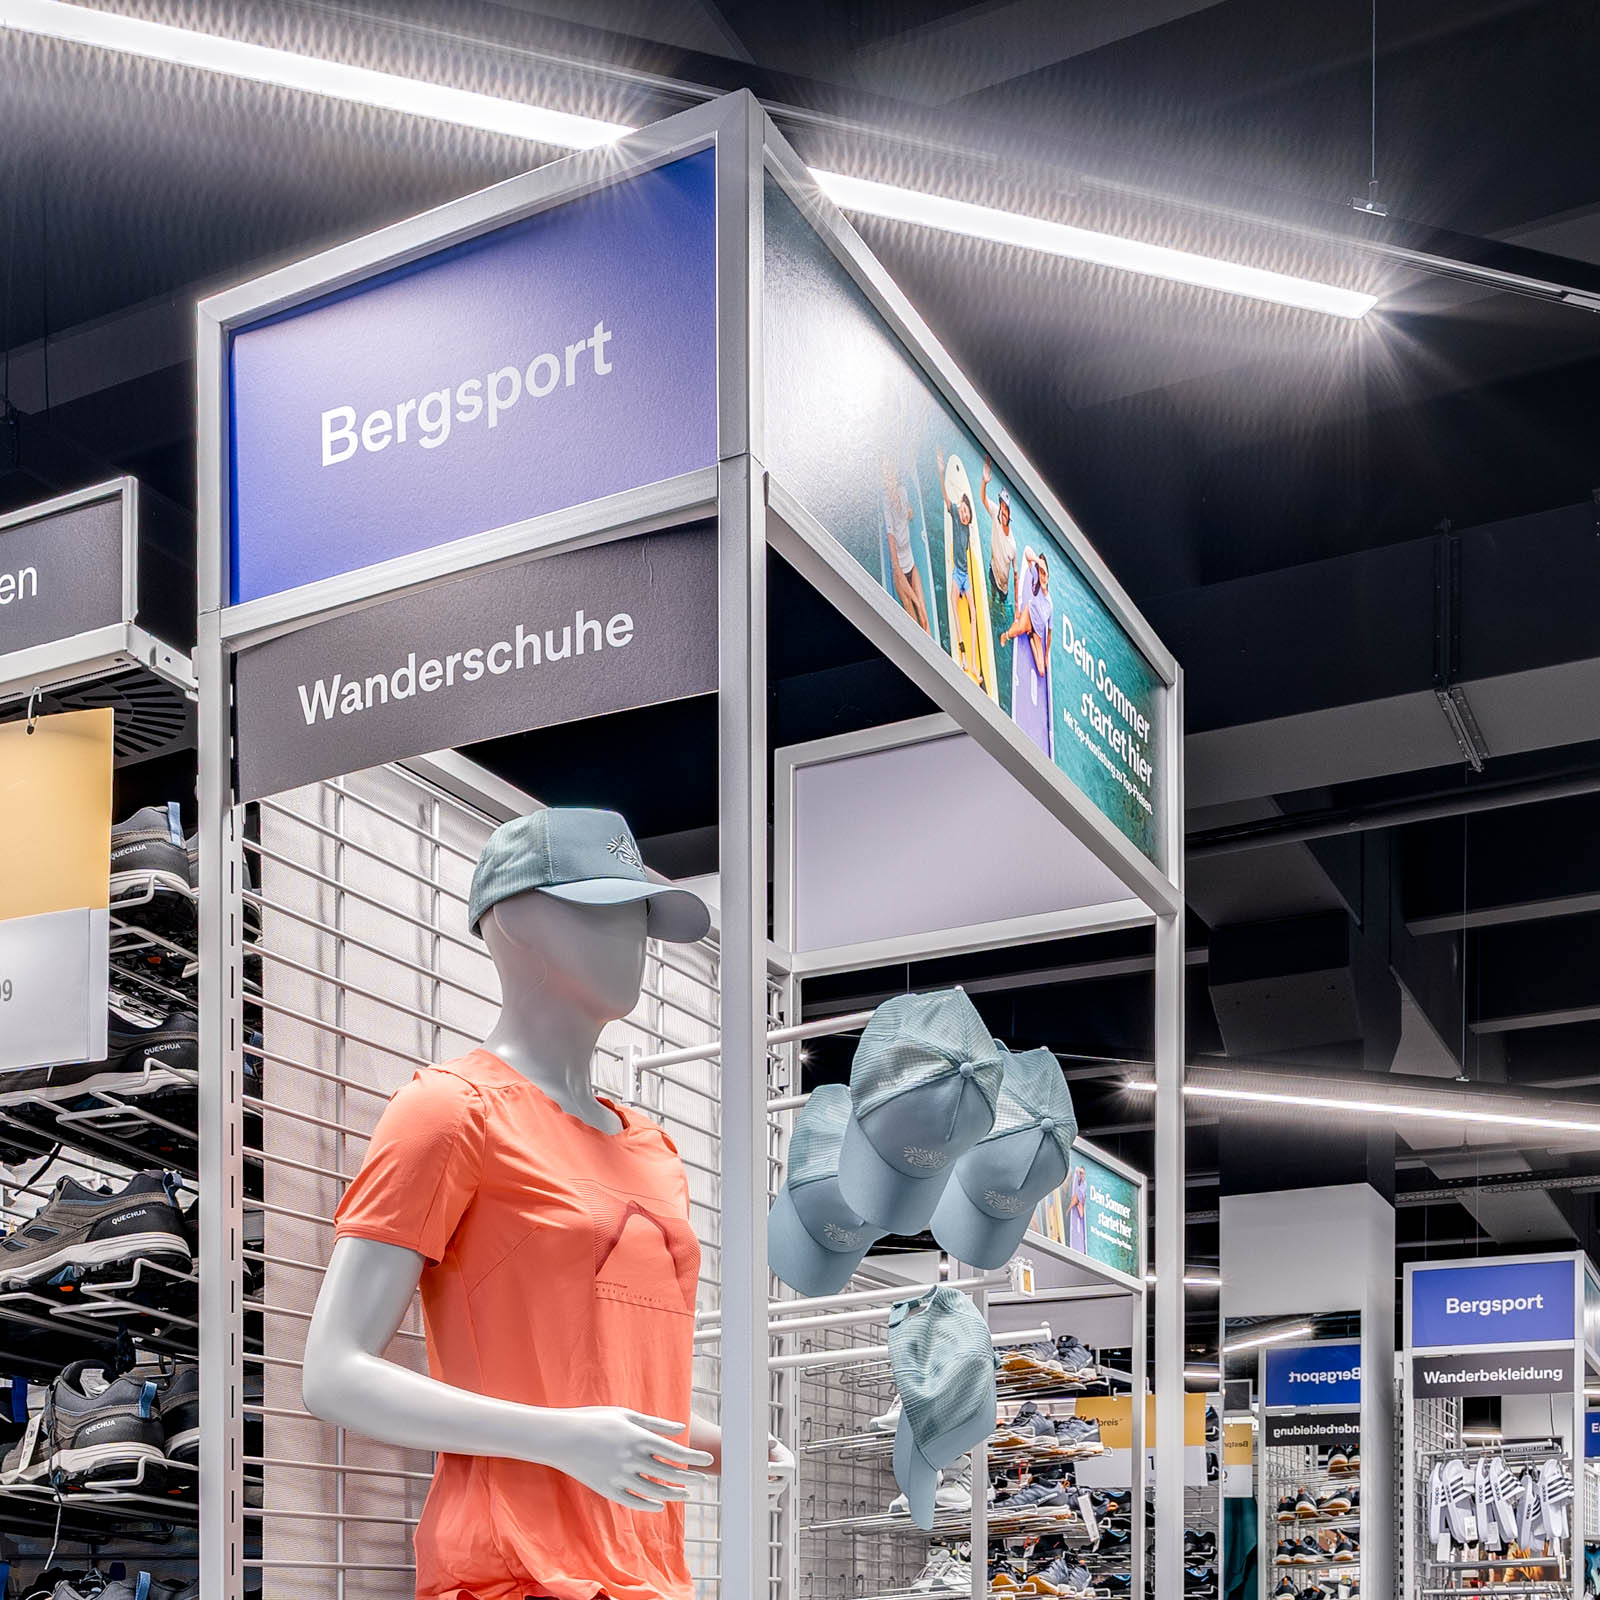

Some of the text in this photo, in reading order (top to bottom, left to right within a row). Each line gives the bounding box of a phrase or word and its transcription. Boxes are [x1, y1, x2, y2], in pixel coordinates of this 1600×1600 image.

[319, 320, 614, 468] Bergsport
[297, 609, 635, 726] Wanderschuhe
[1062, 613, 1150, 743] Dein Sommer
[1063, 708, 1074, 731] Mit
[1081, 692, 1153, 787] startet hier
[111, 843, 147, 861] QUECHUA
[144, 1042, 181, 1056] QUECHUA
[1090, 1184, 1131, 1219] Dein Sommer
[111, 1208, 148, 1226] QUECHUA
[1445, 1293, 1545, 1317] Bergsport
[1423, 1366, 1563, 1385] Wanderbekleidung
[84, 1419, 117, 1435] QUECHUA
